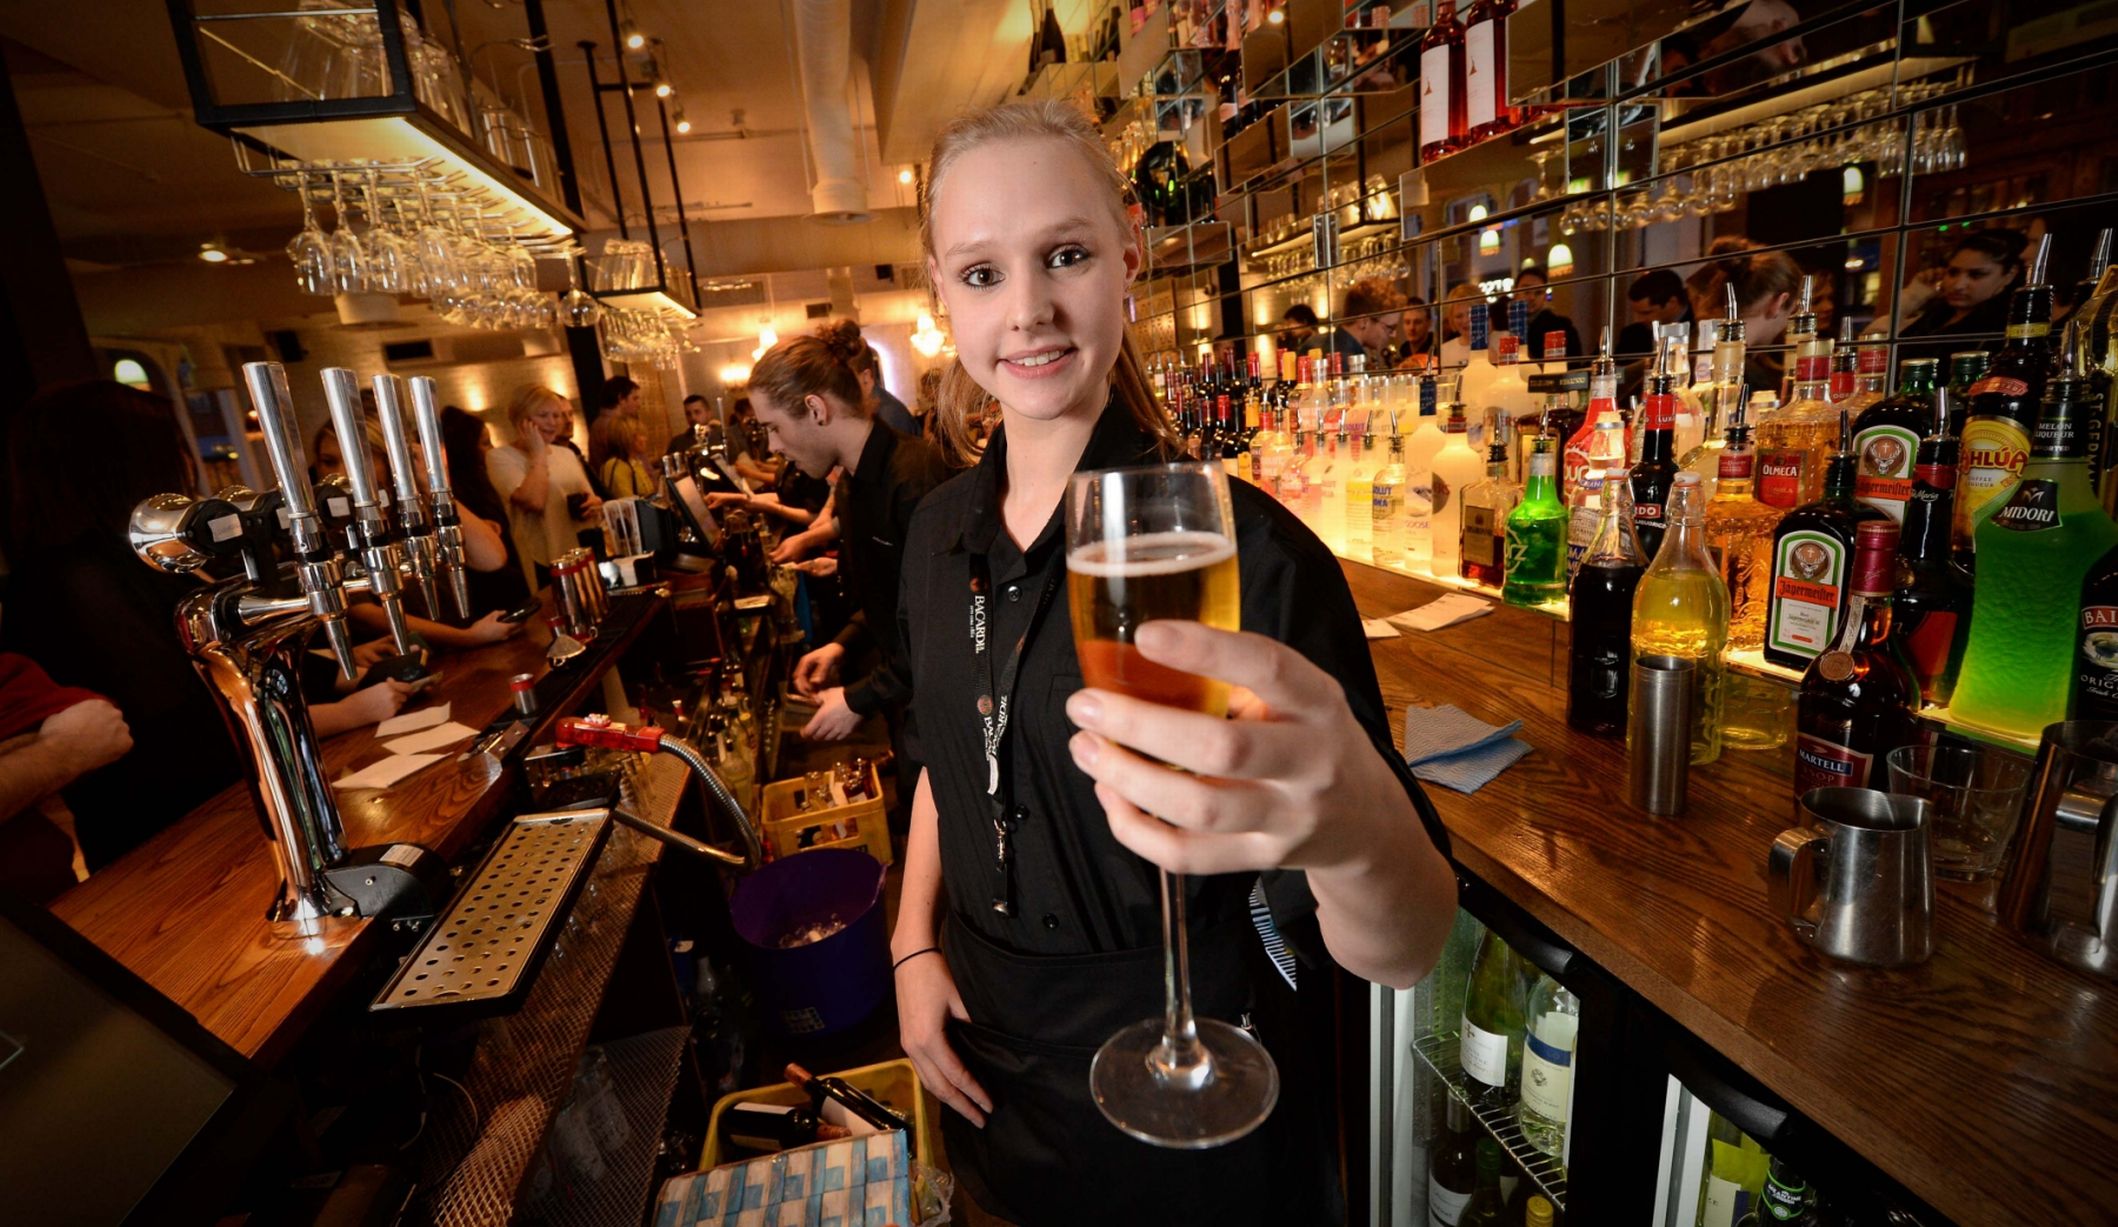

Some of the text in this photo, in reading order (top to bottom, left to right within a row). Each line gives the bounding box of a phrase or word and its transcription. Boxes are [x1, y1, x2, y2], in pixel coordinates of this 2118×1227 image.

[2038, 422, 2072, 430] MELON
[1961, 446, 2029, 477] AHLÚA
[1762, 464, 1797, 477] OLMECA
[2000, 506, 2055, 522] MIDORI
[1800, 749, 1845, 772] MARTELL
